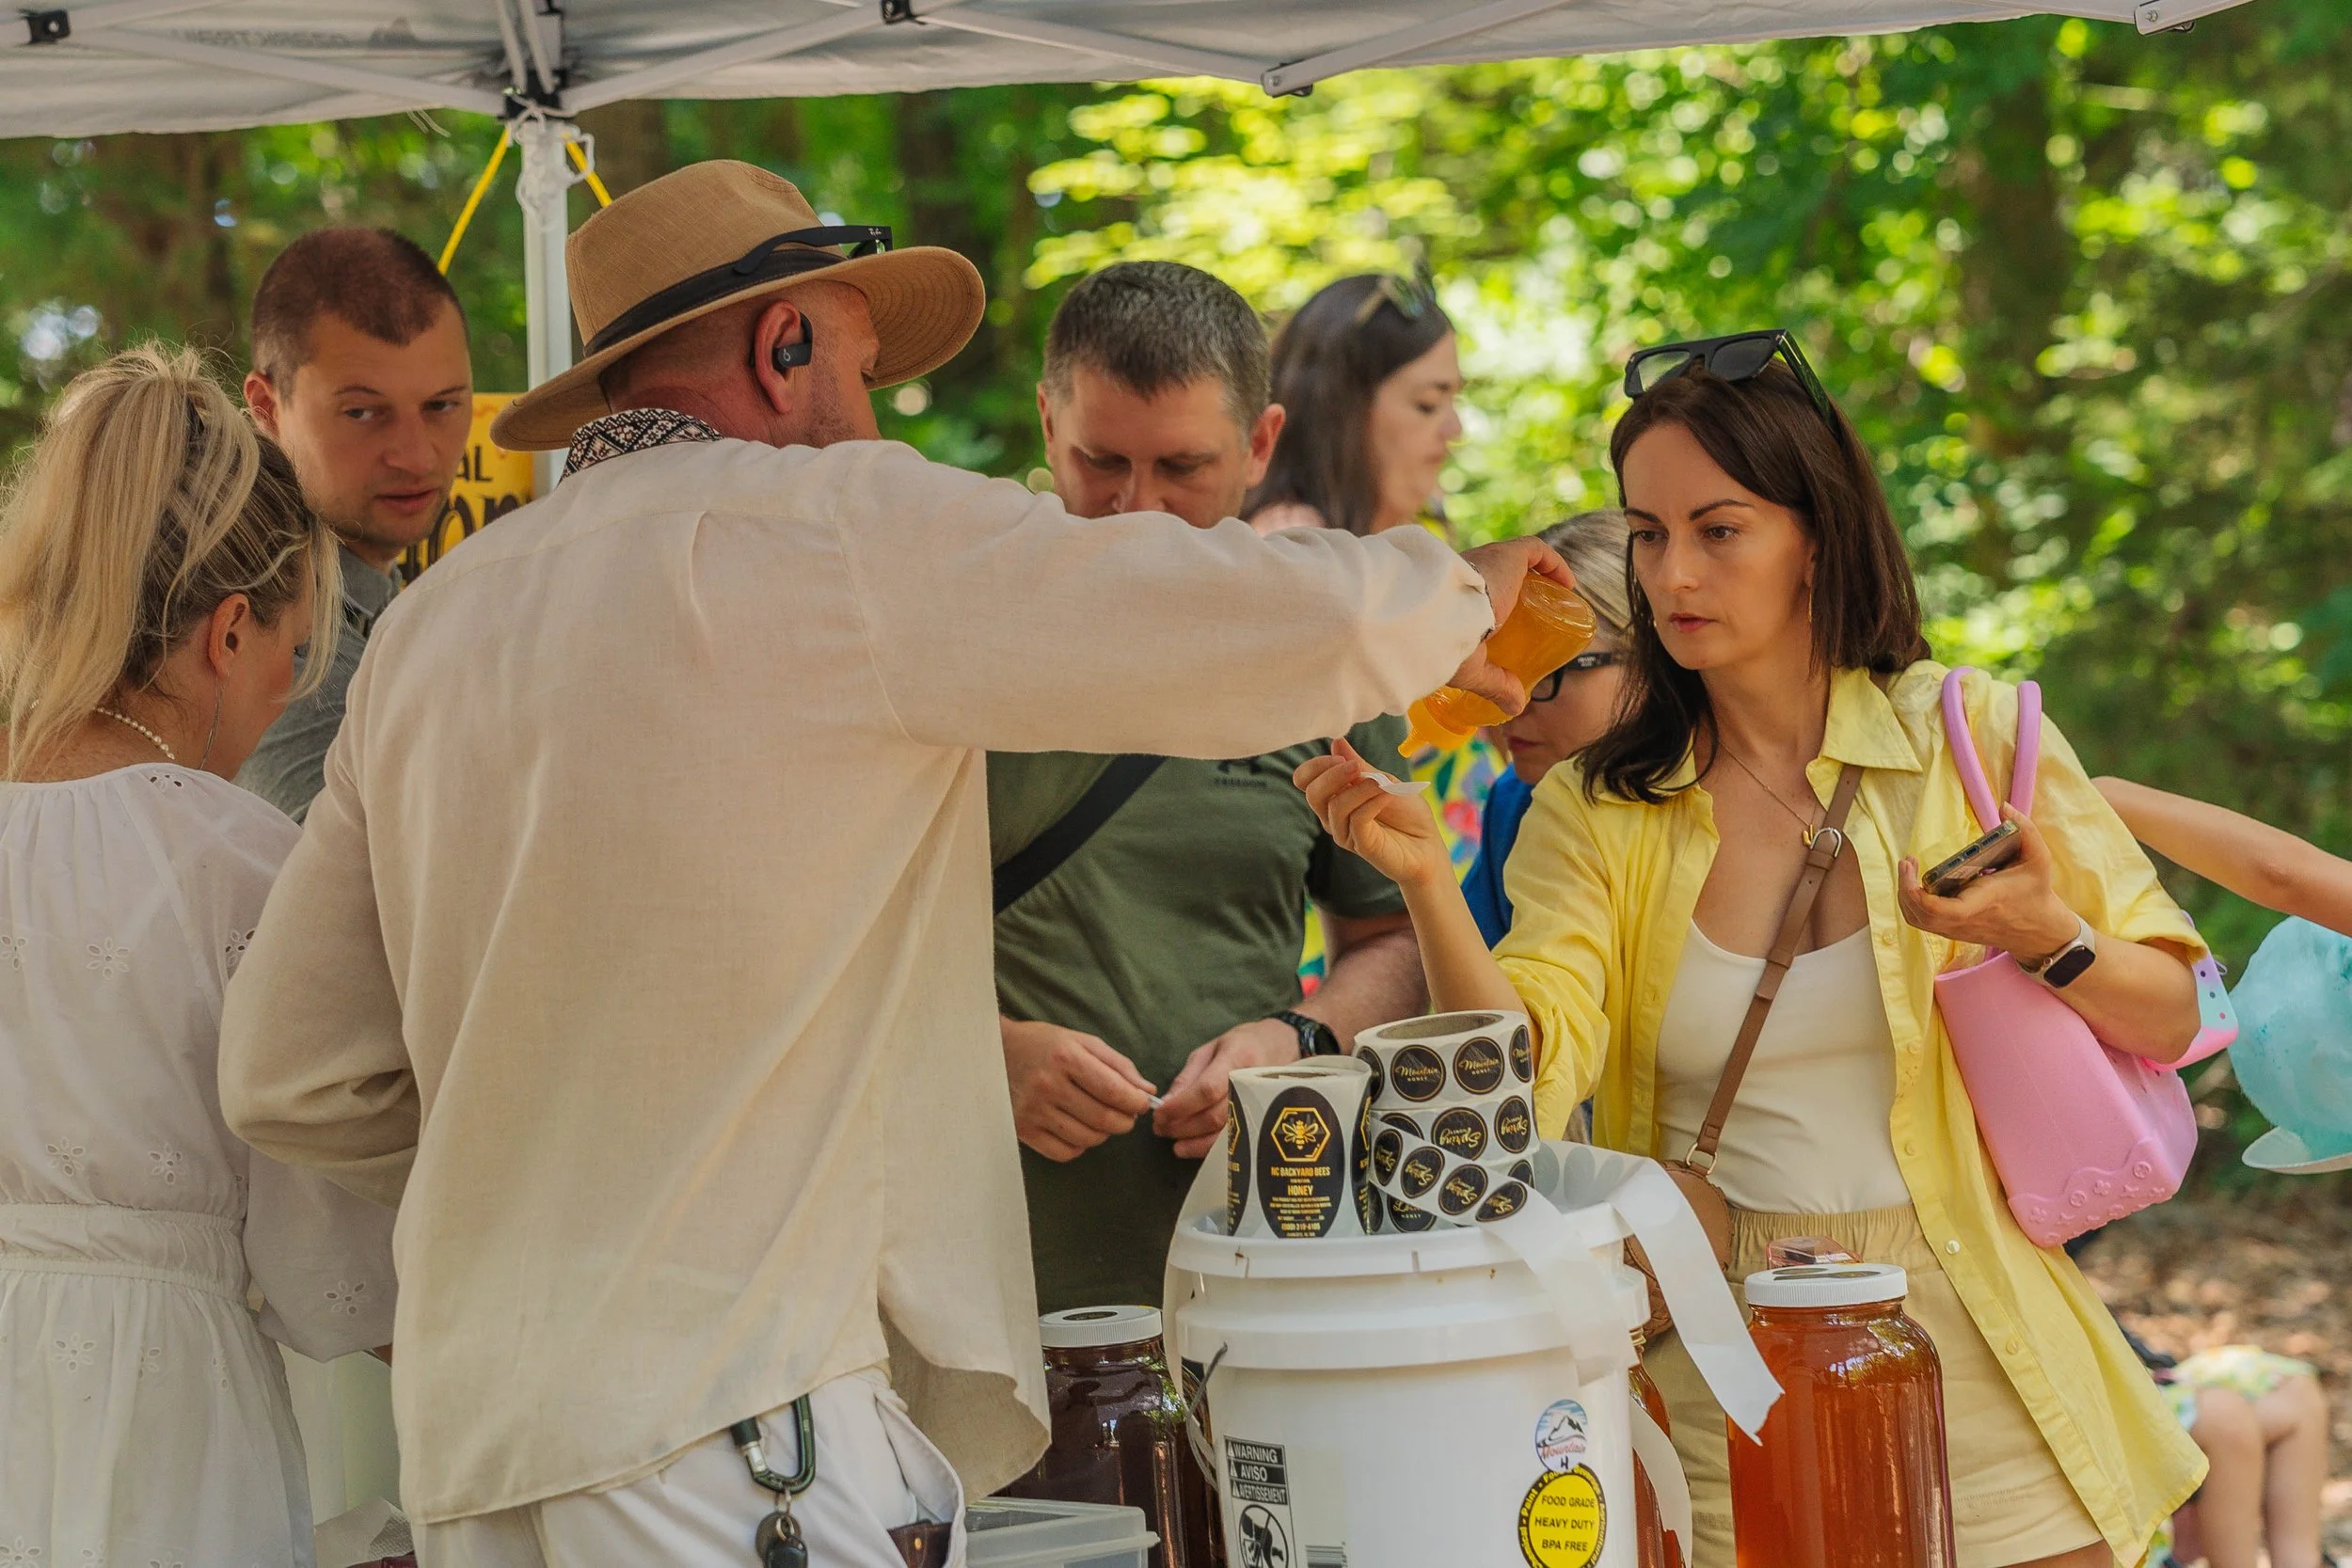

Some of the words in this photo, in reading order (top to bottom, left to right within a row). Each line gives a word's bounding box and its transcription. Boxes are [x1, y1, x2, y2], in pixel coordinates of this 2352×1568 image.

[1395, 1065, 1438, 1077] Mountain
[1459, 1058, 1499, 1069] Mountain
[1439, 1127, 1482, 1148] Spring
[1280, 1166, 1314, 1177] BACKYARD
[1314, 1166, 1331, 1177] BEES
[1287, 1185, 1313, 1196] HONEY
[1233, 1443, 1278, 1464] WARNING
[1541, 1439, 1586, 1459] Mountain
[1560, 1455, 1569, 1470] H
[1241, 1465, 1268, 1482] AVISO
[1239, 1484, 1286, 1504] AVERTISSEMENT
[1541, 1495, 1566, 1507] FOOD
[1568, 1497, 1596, 1508] GRADE
[1521, 1487, 1538, 1517] Paint
[1534, 1515, 1568, 1528] HEAVY
[1570, 1518, 1595, 1530] DUTY
[1542, 1539, 1562, 1550] BPA
[1564, 1541, 1589, 1552] FREE
